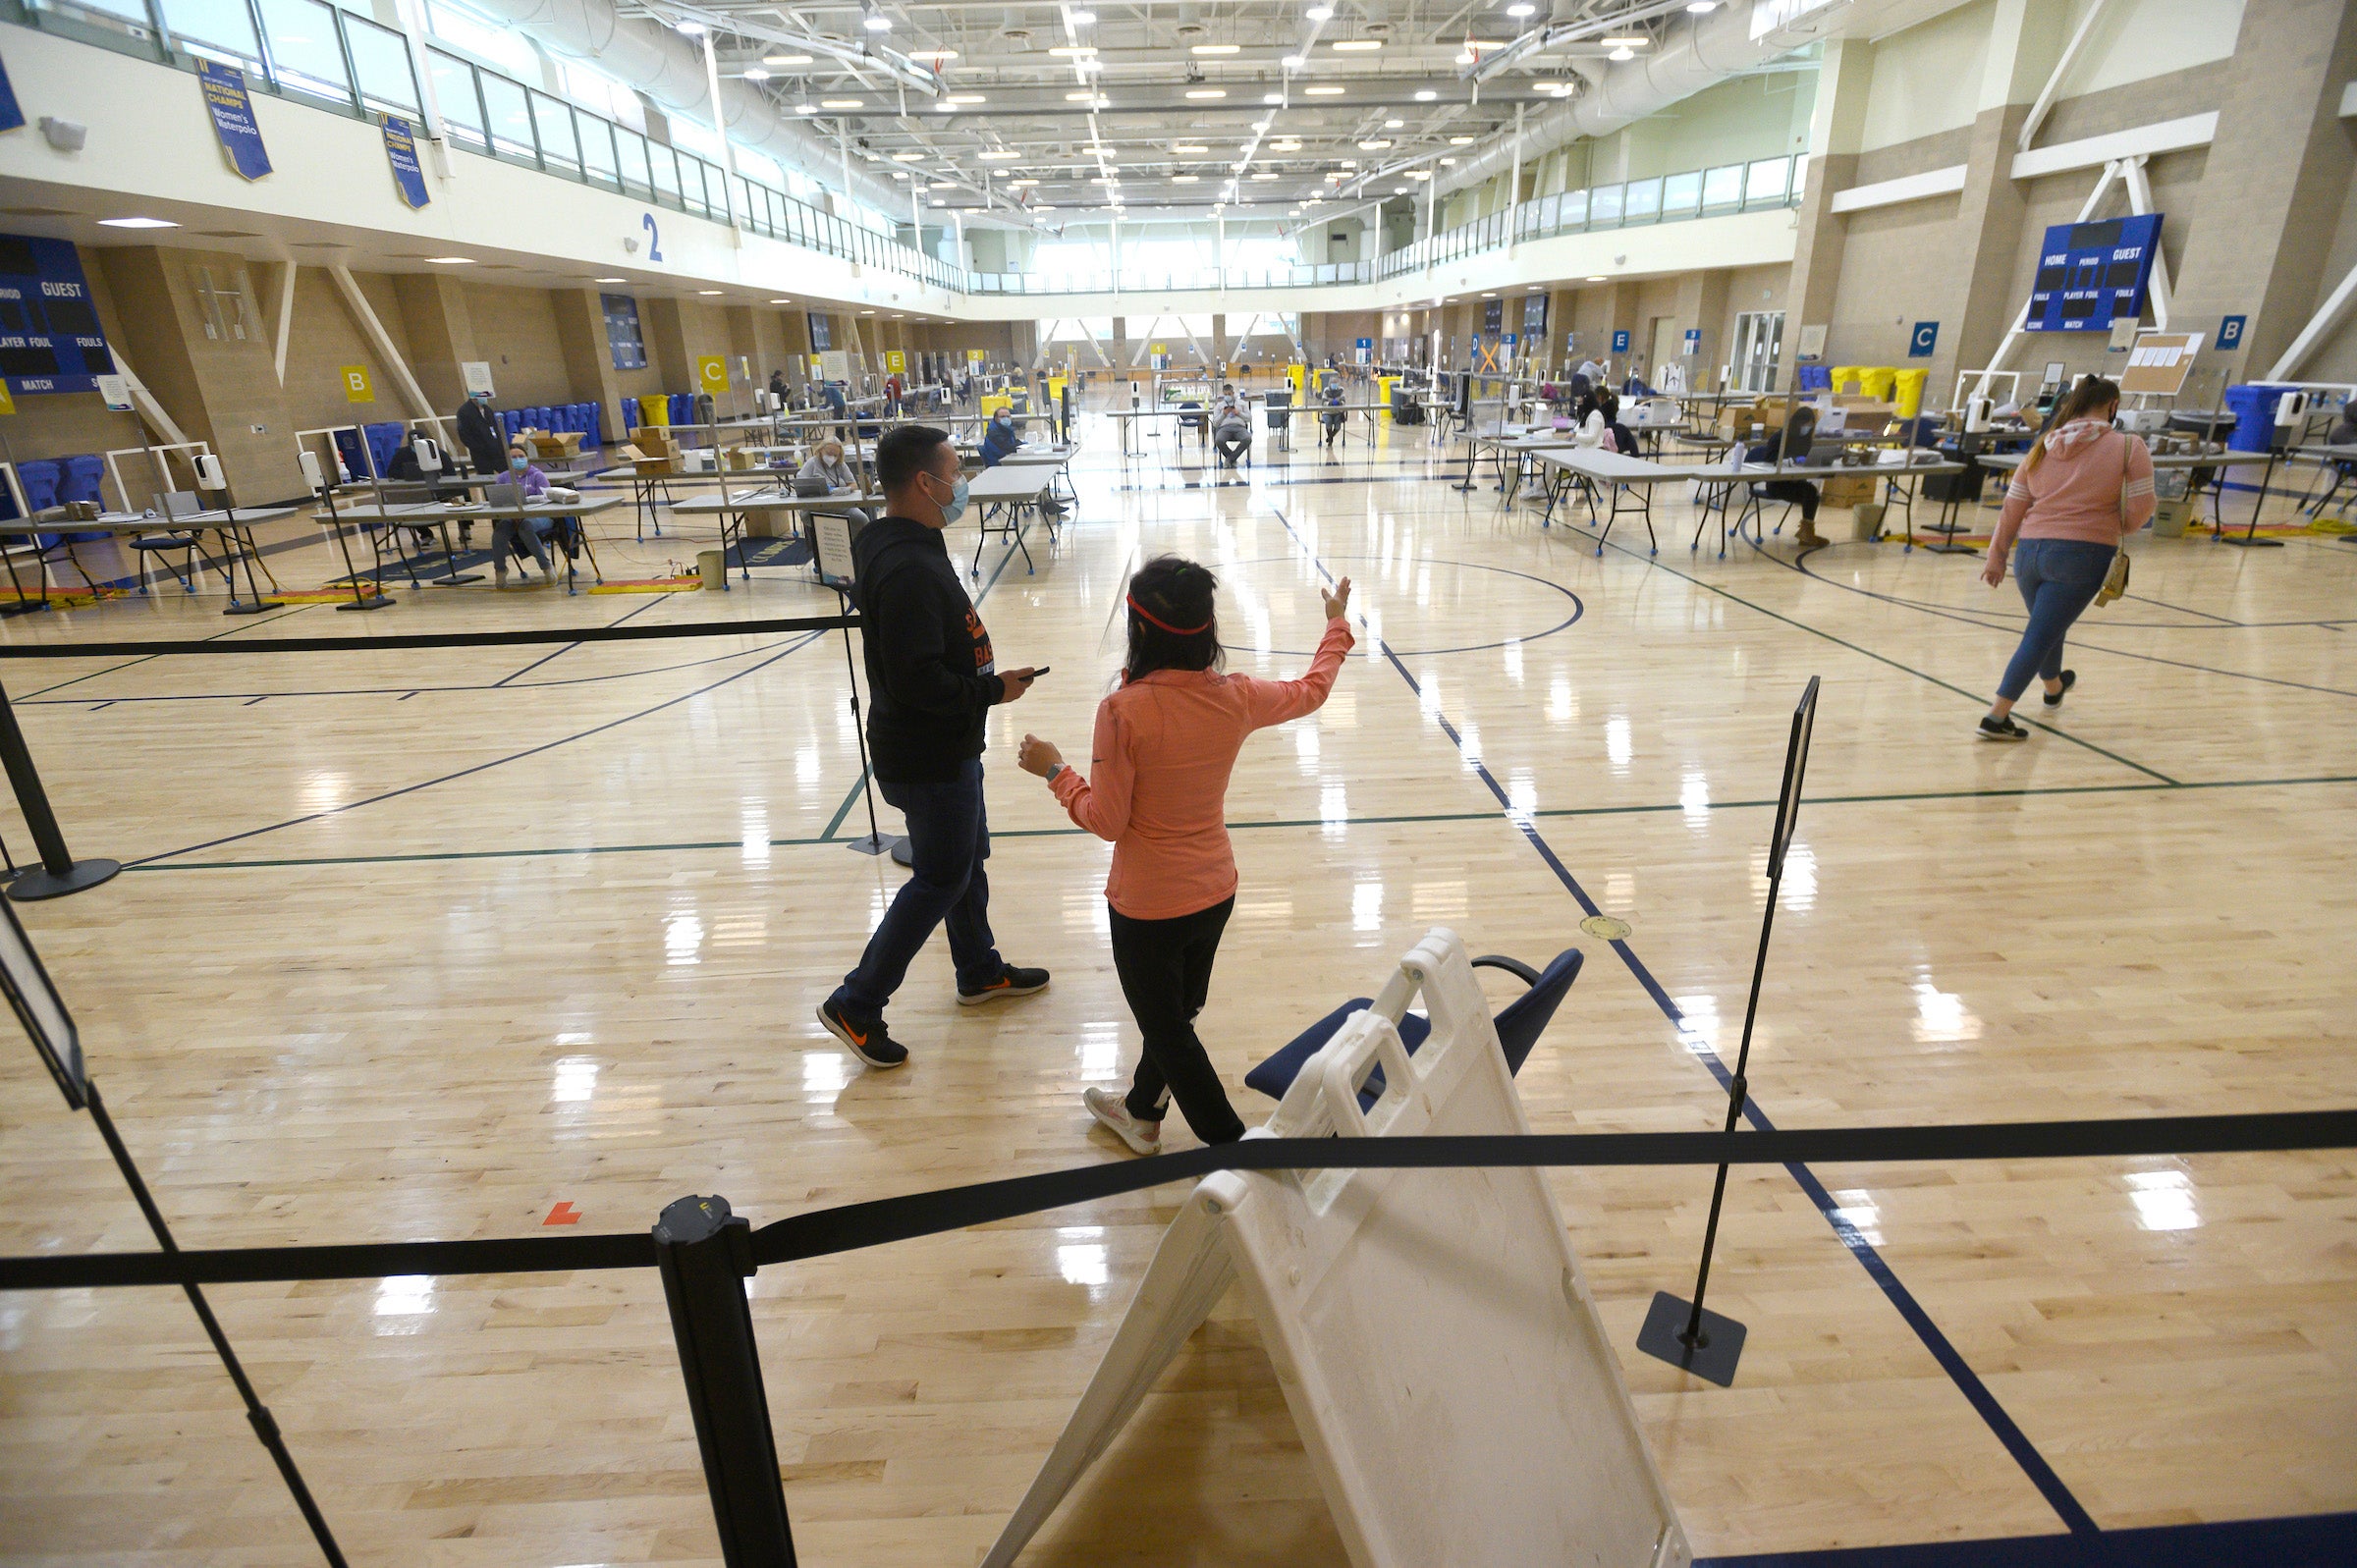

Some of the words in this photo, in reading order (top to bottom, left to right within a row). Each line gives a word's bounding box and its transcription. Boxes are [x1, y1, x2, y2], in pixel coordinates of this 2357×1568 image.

[204, 81, 247, 100] NATIONAL
[207, 93, 245, 109] CHAMPS
[212, 107, 248, 124] Women's
[216, 118, 257, 135] Waterpolo
[643, 212, 663, 262] 2
[2045, 254, 2066, 266] HOME
[2112, 246, 2141, 260] GUEST
[41, 282, 82, 297] GUEST
[1917, 328, 1933, 347] C
[2223, 322, 2240, 340] B
[28, 337, 53, 348] FOUL
[76, 337, 103, 348] FOULS
[1616, 334, 1626, 347] E
[892, 354, 901, 367] E
[705, 361, 722, 381] C
[22, 379, 54, 391] MATCH
[348, 372, 365, 391] B
